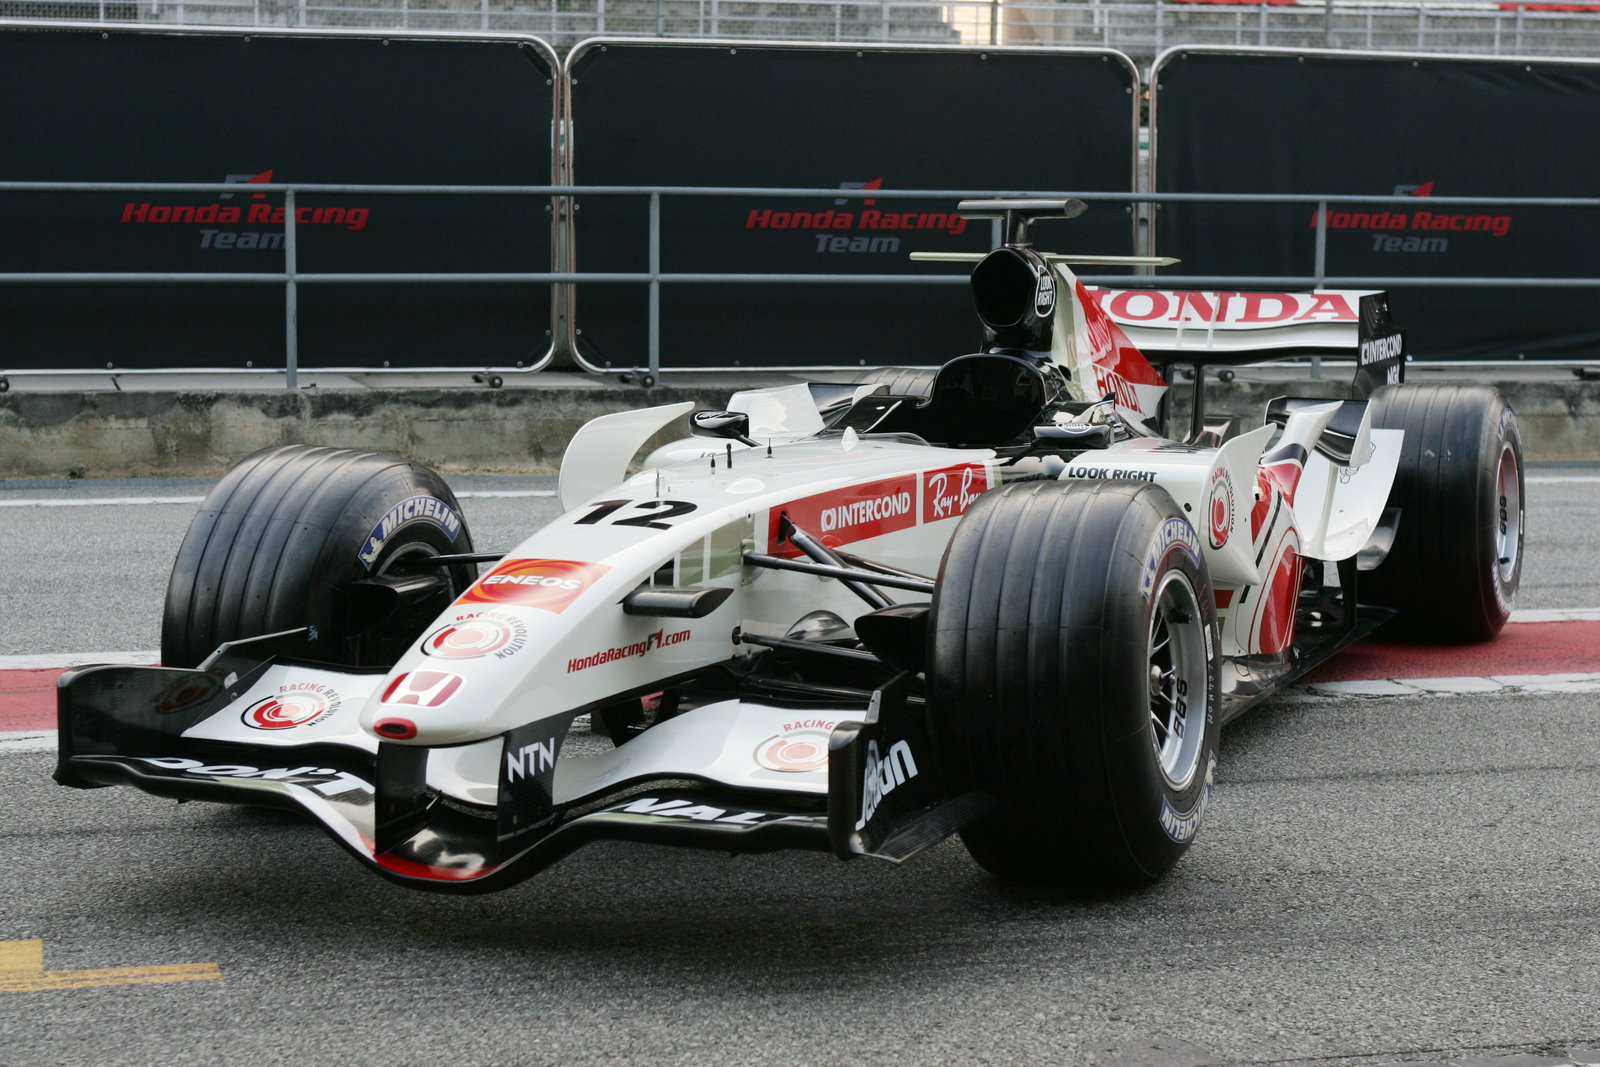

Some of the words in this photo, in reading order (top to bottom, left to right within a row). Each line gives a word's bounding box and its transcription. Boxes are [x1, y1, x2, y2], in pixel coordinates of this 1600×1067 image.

[120, 202, 243, 224] Honda
[246, 203, 371, 231] Racing
[745, 209, 855, 229] Honda
[858, 210, 968, 235] Racing
[1411, 211, 1512, 237] Racing
[199, 229, 287, 249] Team
[815, 234, 900, 253] Team
[1372, 234, 1449, 253] Team
[1040, 275, 1053, 291] LOOK
[1036, 291, 1053, 306] RIGHT
[1369, 333, 1402, 364] INTERCOND
[1068, 466, 1110, 480] LOOK
[1112, 469, 1158, 482] RIGHT
[382, 498, 459, 540] MICHELIN
[573, 499, 698, 531] 12
[838, 492, 911, 529] INTERCOND
[1151, 520, 1200, 564] MICHELIN
[481, 574, 581, 590] ENEOS
[455, 611, 505, 622] RACING
[494, 615, 528, 660] REVOLUTION
[567, 627, 691, 674] HondaRacingF1.com
[279, 682, 326, 693] RACING
[307, 688, 342, 727] REVOLUTION
[1173, 677, 1188, 740] BBS
[783, 719, 834, 732] RACING
[507, 737, 555, 784] NTN
[143, 757, 377, 798] DON'T
